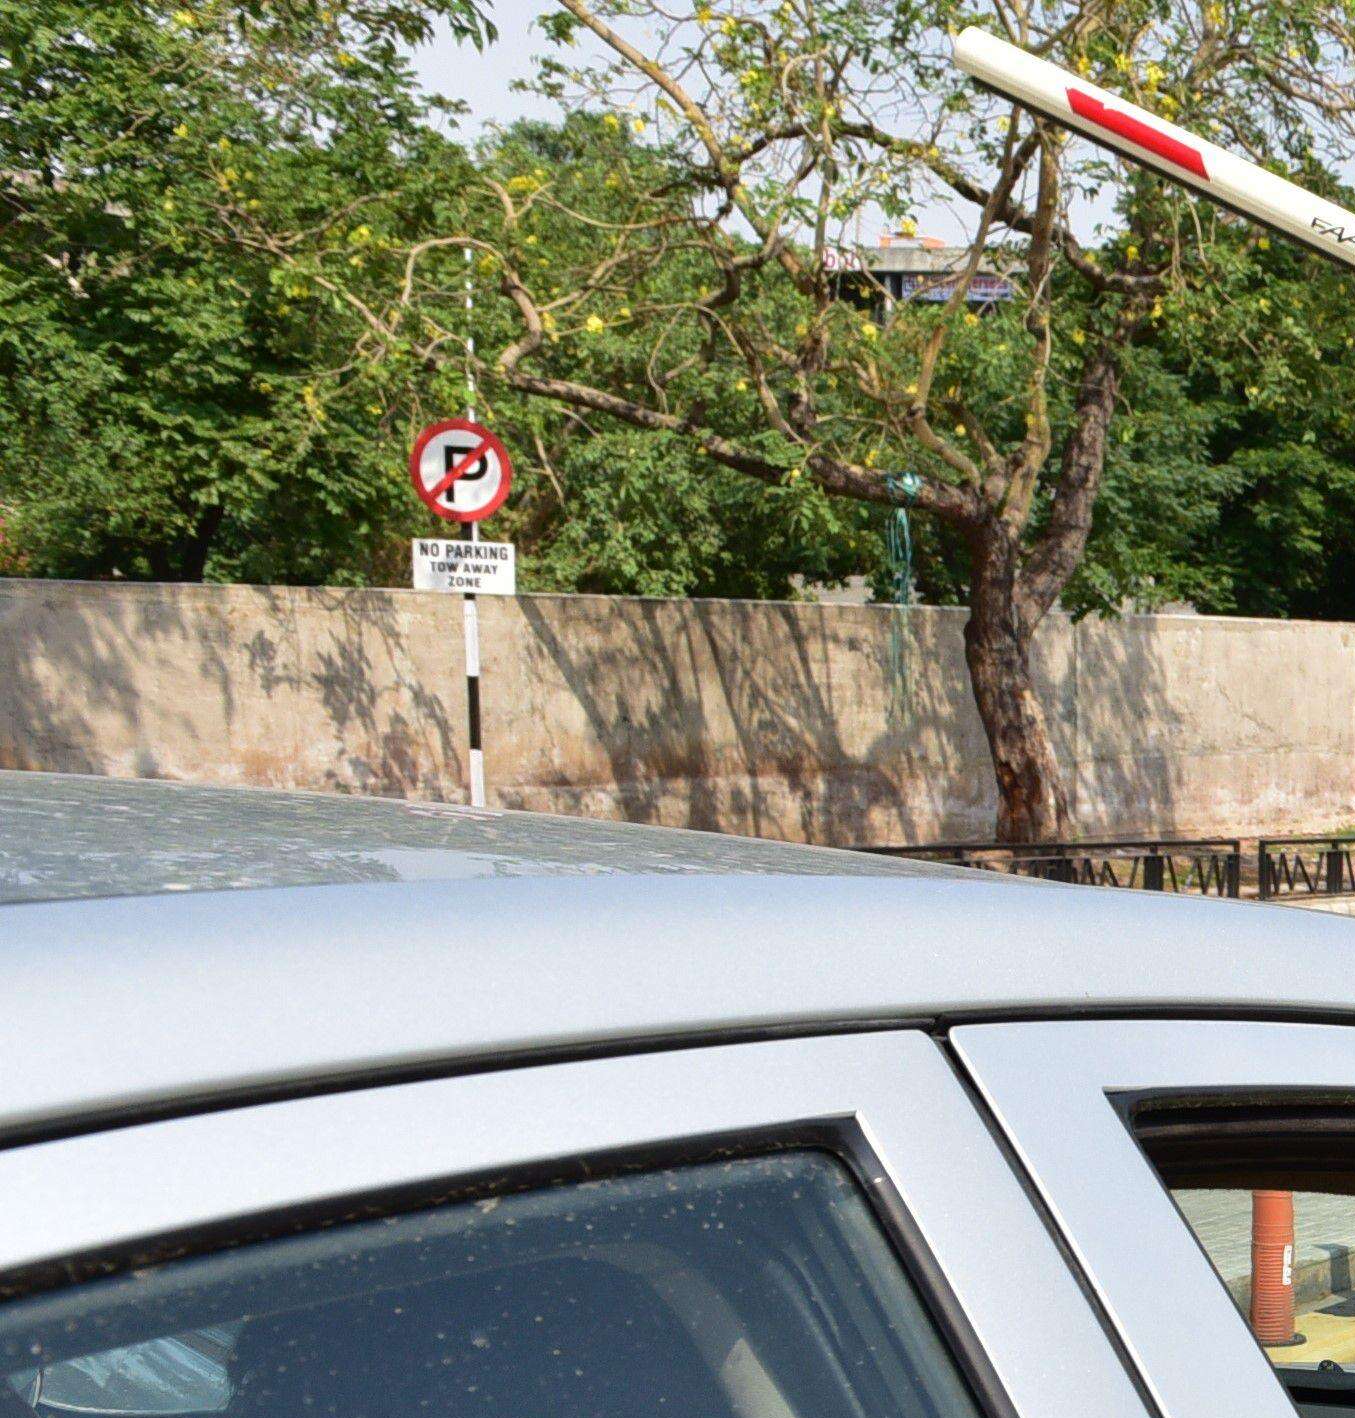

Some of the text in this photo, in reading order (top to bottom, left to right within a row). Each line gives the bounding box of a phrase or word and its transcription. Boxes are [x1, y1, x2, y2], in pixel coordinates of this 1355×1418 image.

[419, 542, 508, 560] NO PARKING
[430, 561, 498, 575] TOW AWAY
[448, 575, 481, 588] ZONE
